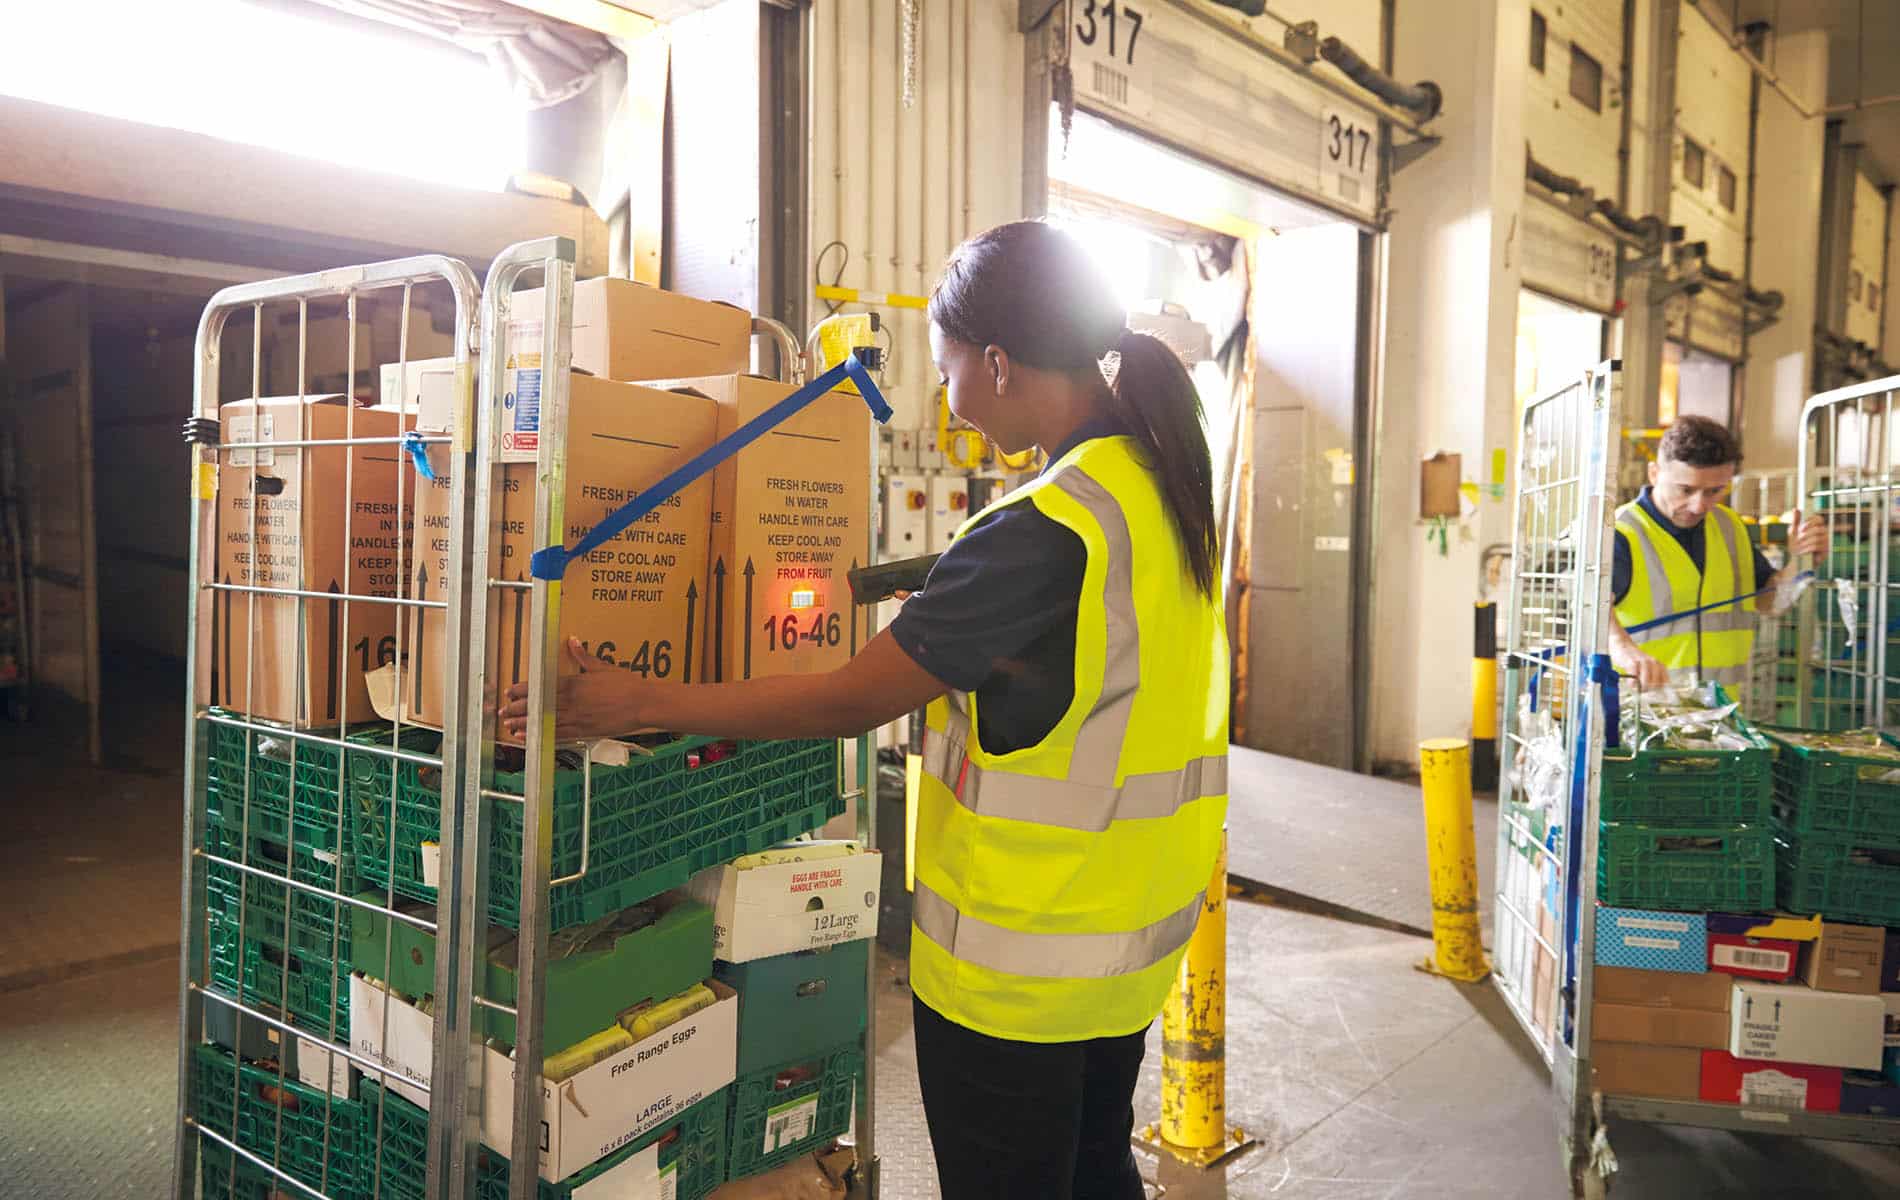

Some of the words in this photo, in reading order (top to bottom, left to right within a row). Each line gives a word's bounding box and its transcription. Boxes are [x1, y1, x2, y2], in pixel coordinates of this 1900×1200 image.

[1076, 0, 1143, 65] 317
[1328, 115, 1370, 174] 317
[582, 485, 623, 501] FRESH
[766, 478, 799, 491] FRESH
[801, 480, 844, 494] FLOWERS
[785, 495, 794, 508] IN
[797, 497, 828, 509] WATER
[380, 519, 392, 531] IN
[759, 513, 799, 526] HANDLE
[801, 515, 824, 527] WITH
[826, 516, 848, 528] CARE
[625, 530, 654, 544] WITH
[657, 532, 686, 546] CARE
[767, 534, 794, 546] KEEP
[797, 535, 822, 547] COOL
[824, 536, 842, 547] AND
[358, 557, 393, 569] KEEP
[582, 551, 614, 564] KEEP
[618, 552, 650, 566] COOL
[653, 554, 676, 567] AND
[776, 551, 808, 563] STORE
[810, 552, 834, 563] AWAY
[592, 569, 632, 583] STORE
[635, 571, 666, 585] AWAY
[777, 568, 805, 580] FROM
[808, 568, 832, 580] FRUIT
[592, 588, 627, 602] FROM
[631, 589, 664, 602] FRUIT
[763, 612, 841, 652] 16-46
[354, 635, 409, 672] 16-
[793, 871, 807, 883] EGGS
[808, 871, 819, 881] ARE
[790, 882, 812, 893] HANDLE
[611, 1059, 634, 1078] Free
[637, 1040, 669, 1063] Range
[672, 1025, 697, 1044] Eggs
[636, 1094, 672, 1122] LARGE
[600, 1143, 610, 1155] 16
[624, 1125, 642, 1143] pack
[643, 1108, 674, 1130] contains
